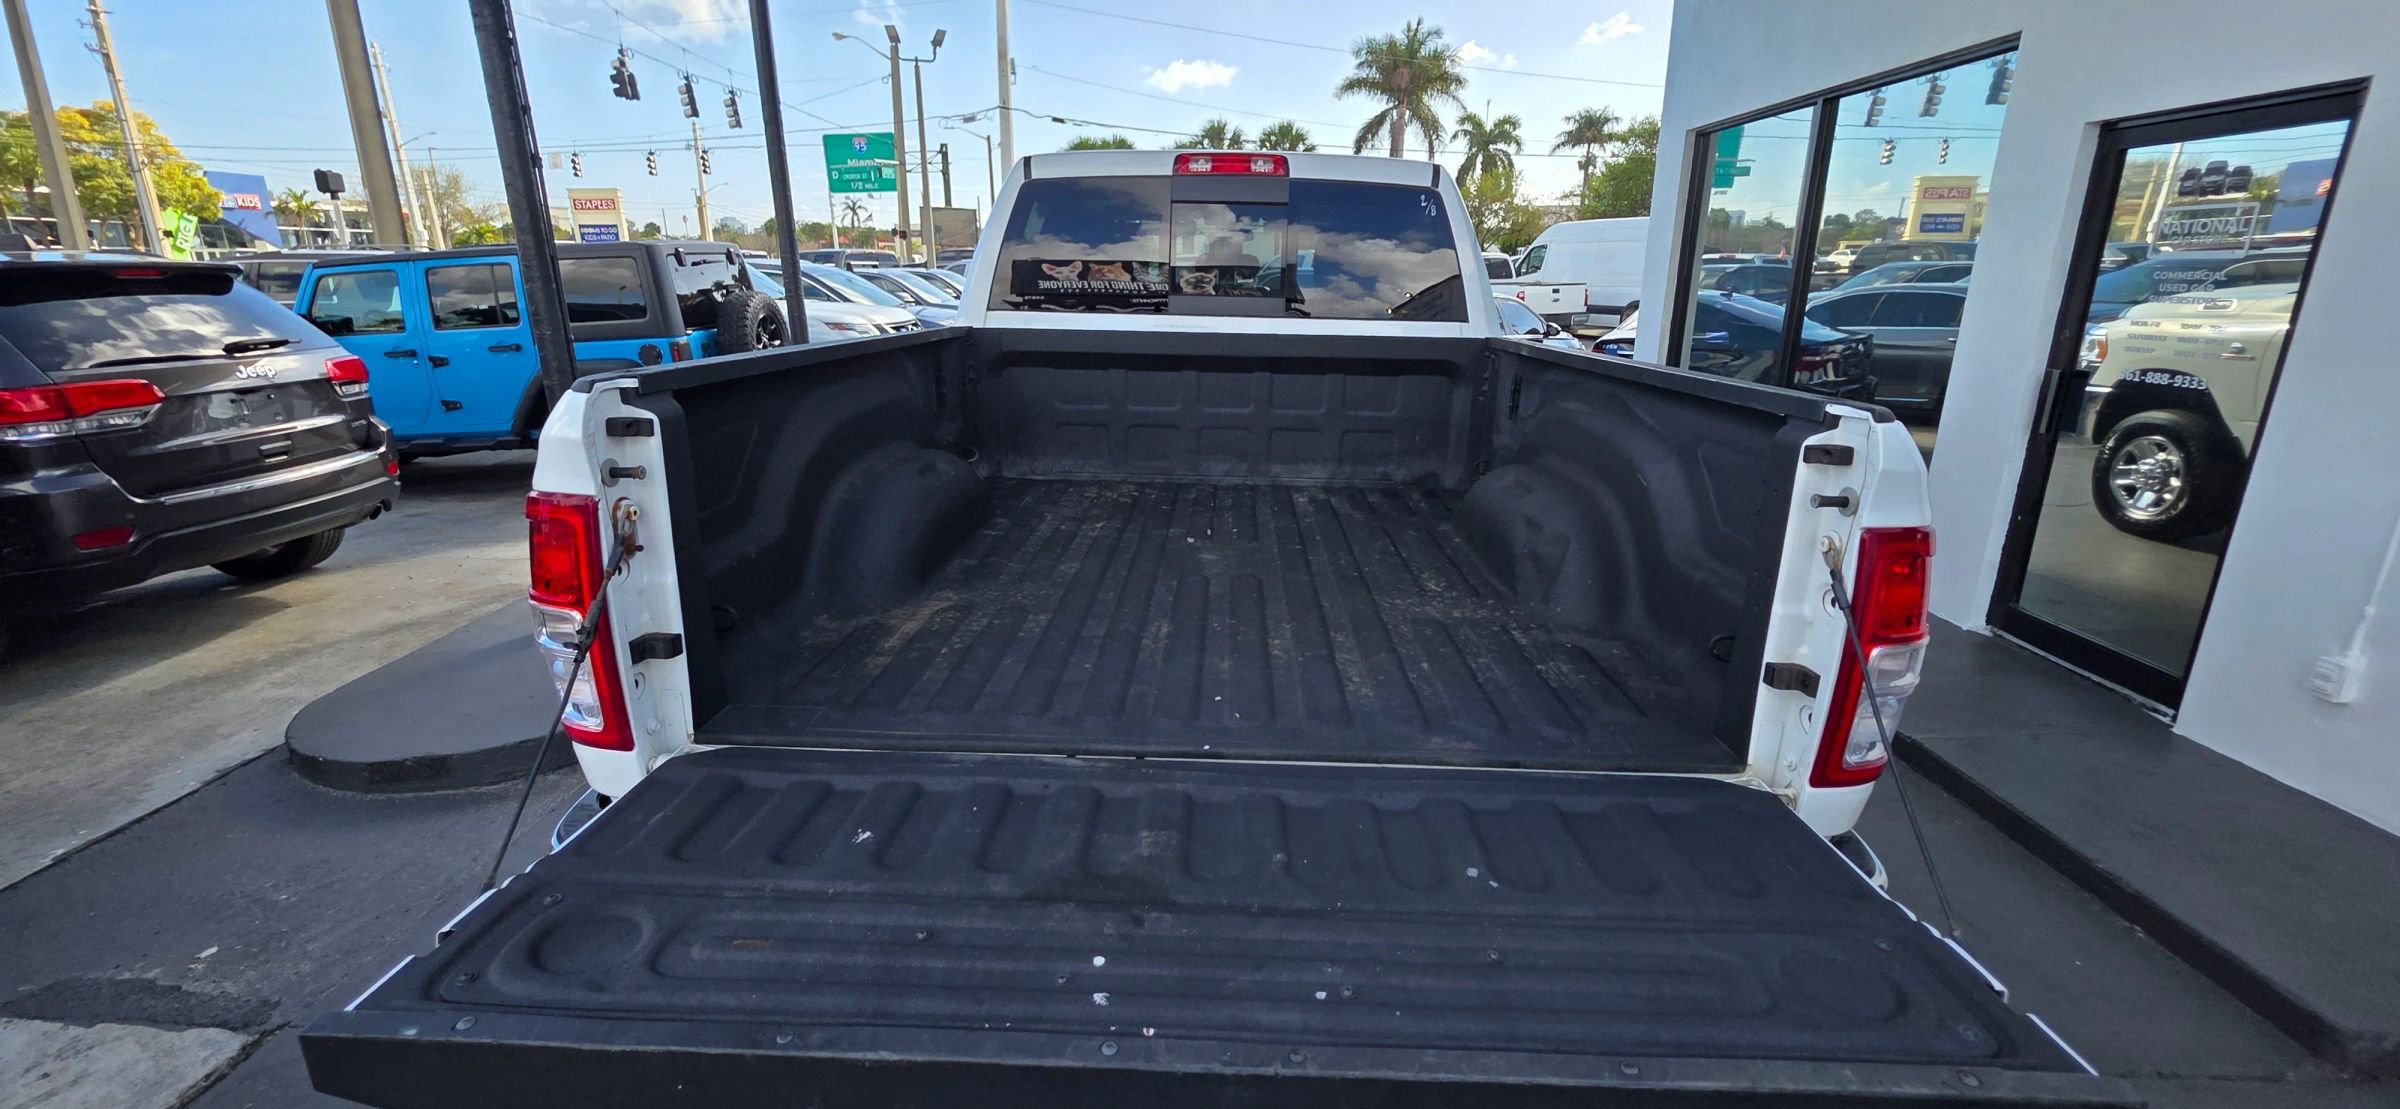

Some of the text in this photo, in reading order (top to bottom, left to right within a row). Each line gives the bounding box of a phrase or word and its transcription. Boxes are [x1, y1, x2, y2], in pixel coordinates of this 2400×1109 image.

[854, 142, 867, 151] 95
[236, 194, 261, 208] KIDS
[574, 199, 615, 210] STAPLES
[1420, 194, 1437, 216] 2/8
[2157, 218, 2249, 235] NATIONAL
[2152, 271, 2228, 281] COMMERCIAL
[2159, 283, 2216, 293] USED CAR
[235, 364, 277, 379] Jeep
